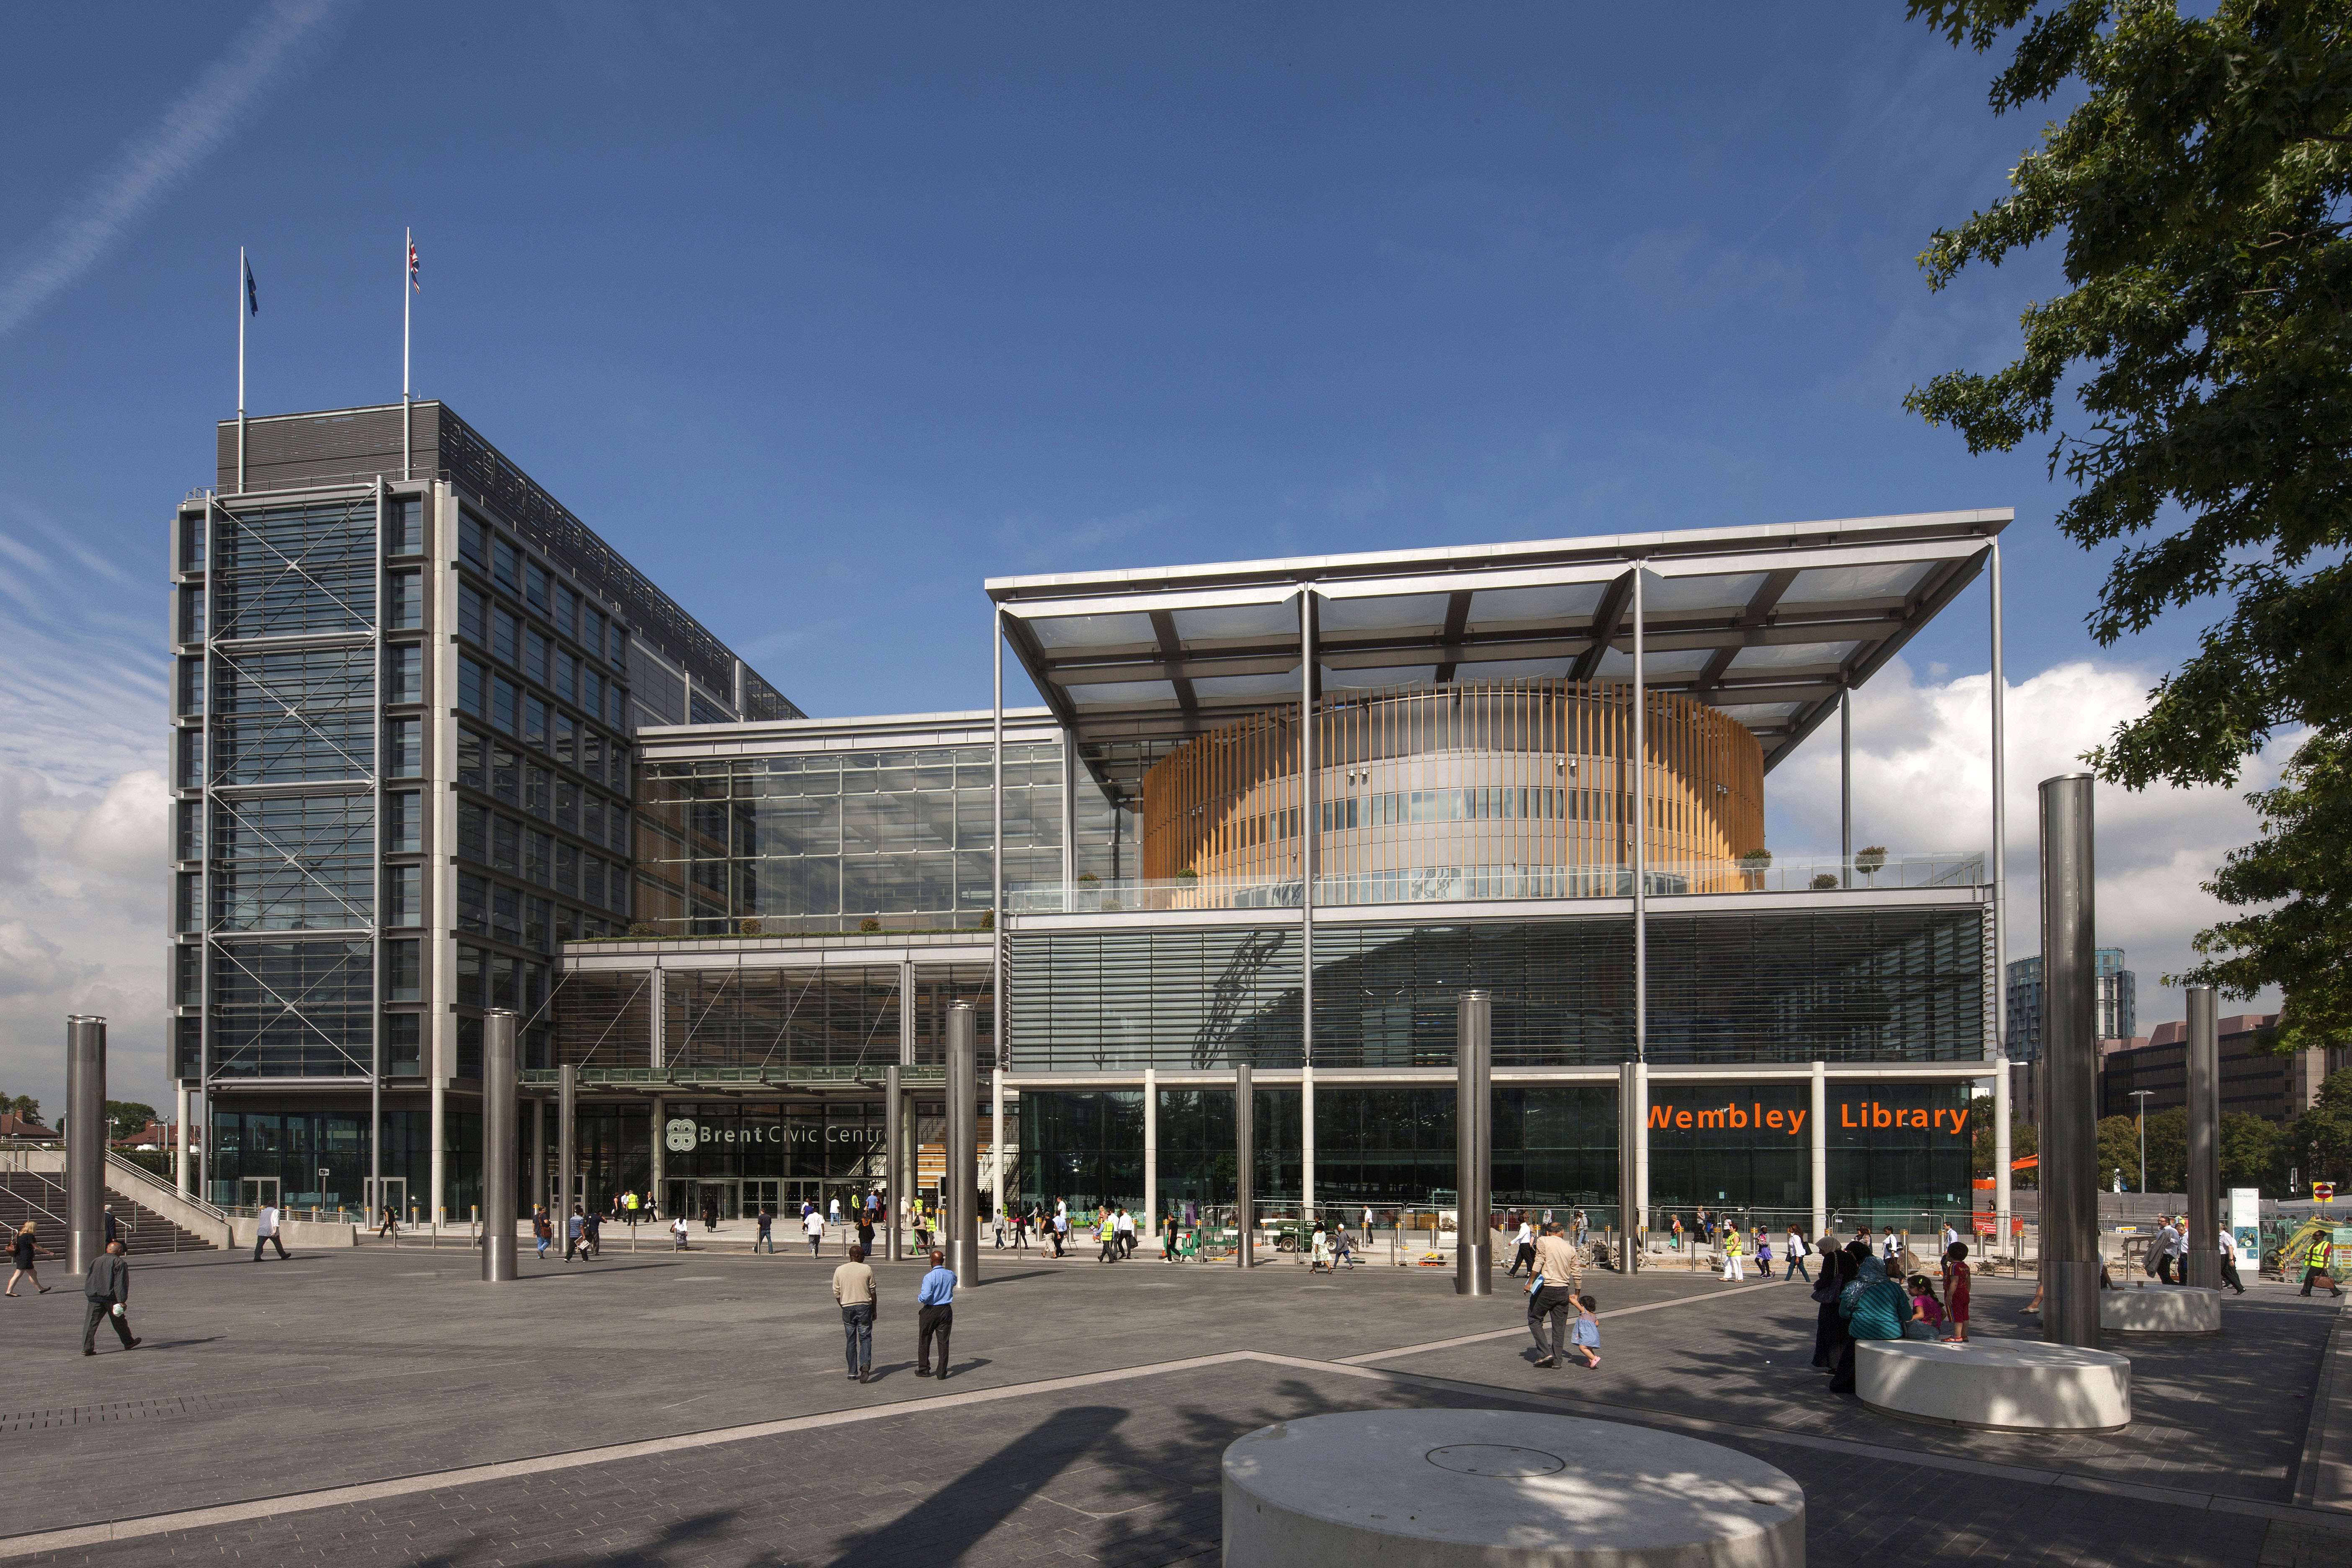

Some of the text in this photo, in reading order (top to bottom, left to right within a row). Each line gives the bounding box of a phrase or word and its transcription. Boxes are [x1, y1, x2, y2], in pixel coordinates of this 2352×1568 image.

[1648, 1102, 1968, 1135] Wembley Library
[700, 1125, 886, 1142] Brent Civic Centr
